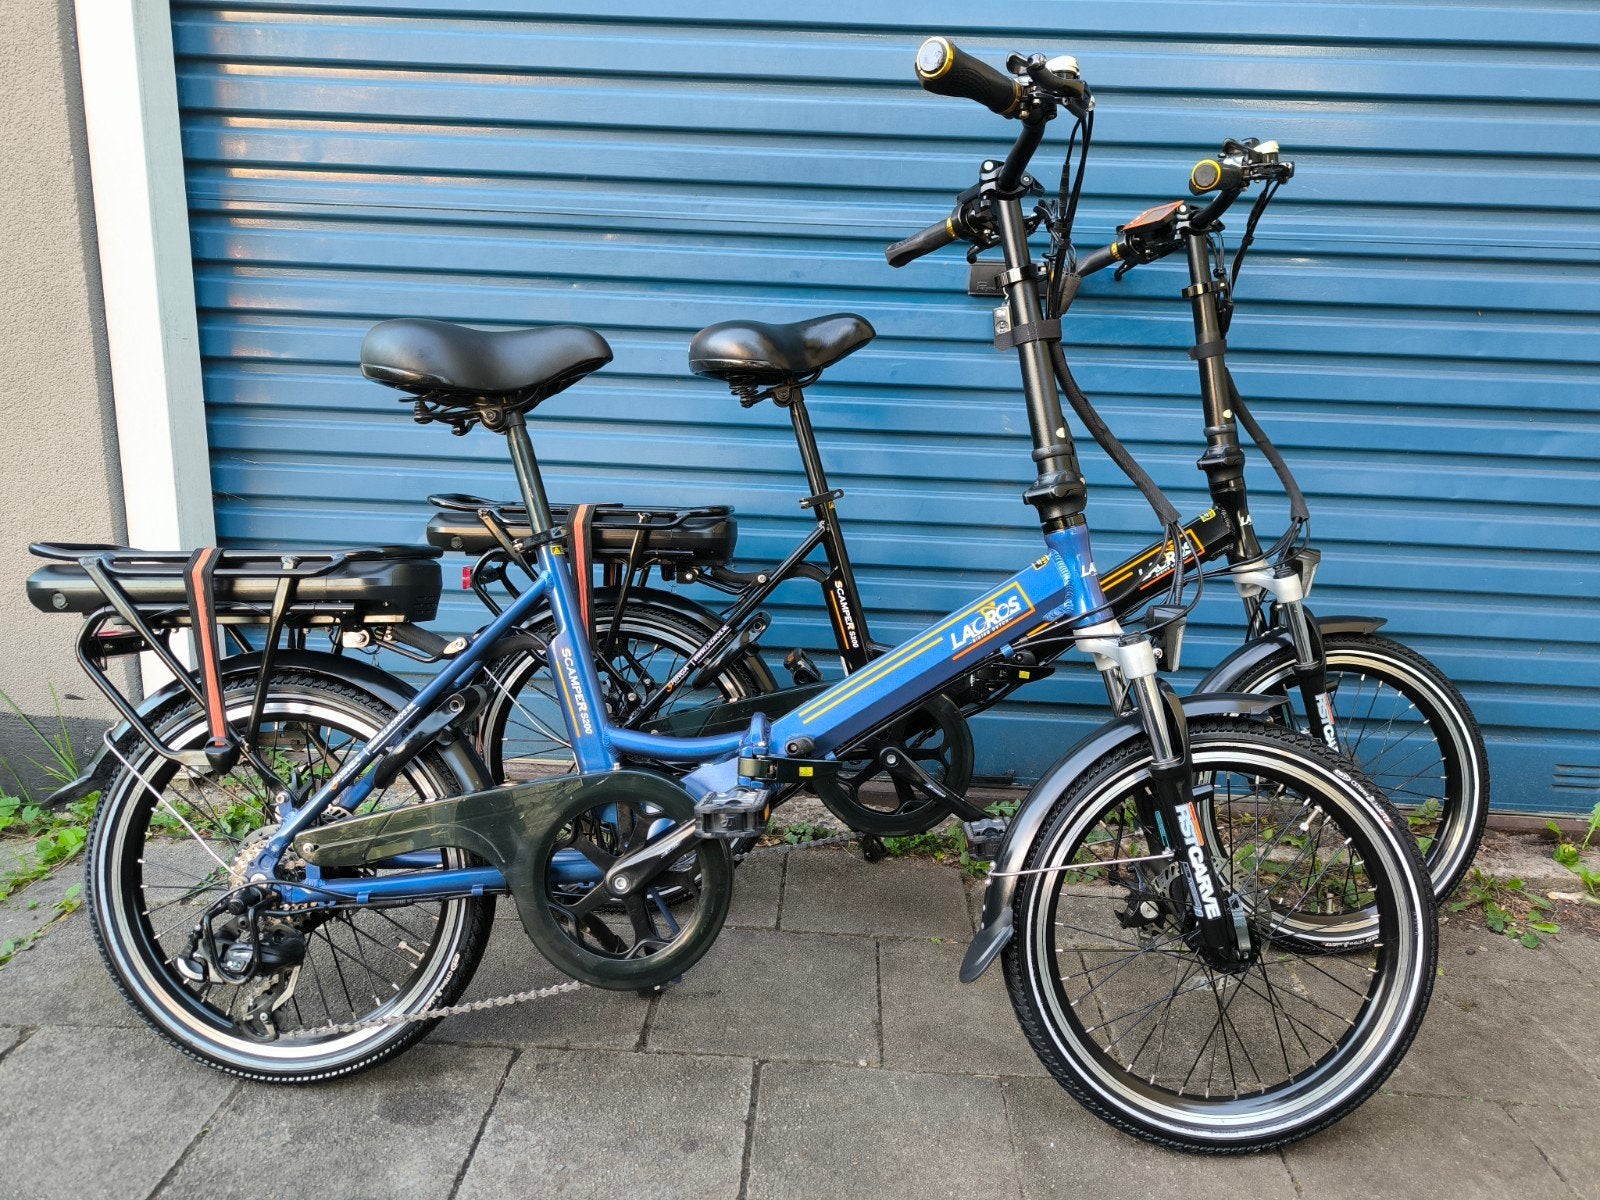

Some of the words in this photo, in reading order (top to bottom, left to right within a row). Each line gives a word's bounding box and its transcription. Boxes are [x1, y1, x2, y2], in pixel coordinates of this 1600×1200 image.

[834, 579, 856, 631] SCAMPER
[849, 630, 860, 648] S200
[950, 595, 1022, 651] LACROS
[561, 647, 588, 712] SCAMPER
[580, 711, 593, 735] S200
[1174, 803, 1200, 848] RST
[1187, 845, 1222, 920] CARVE
